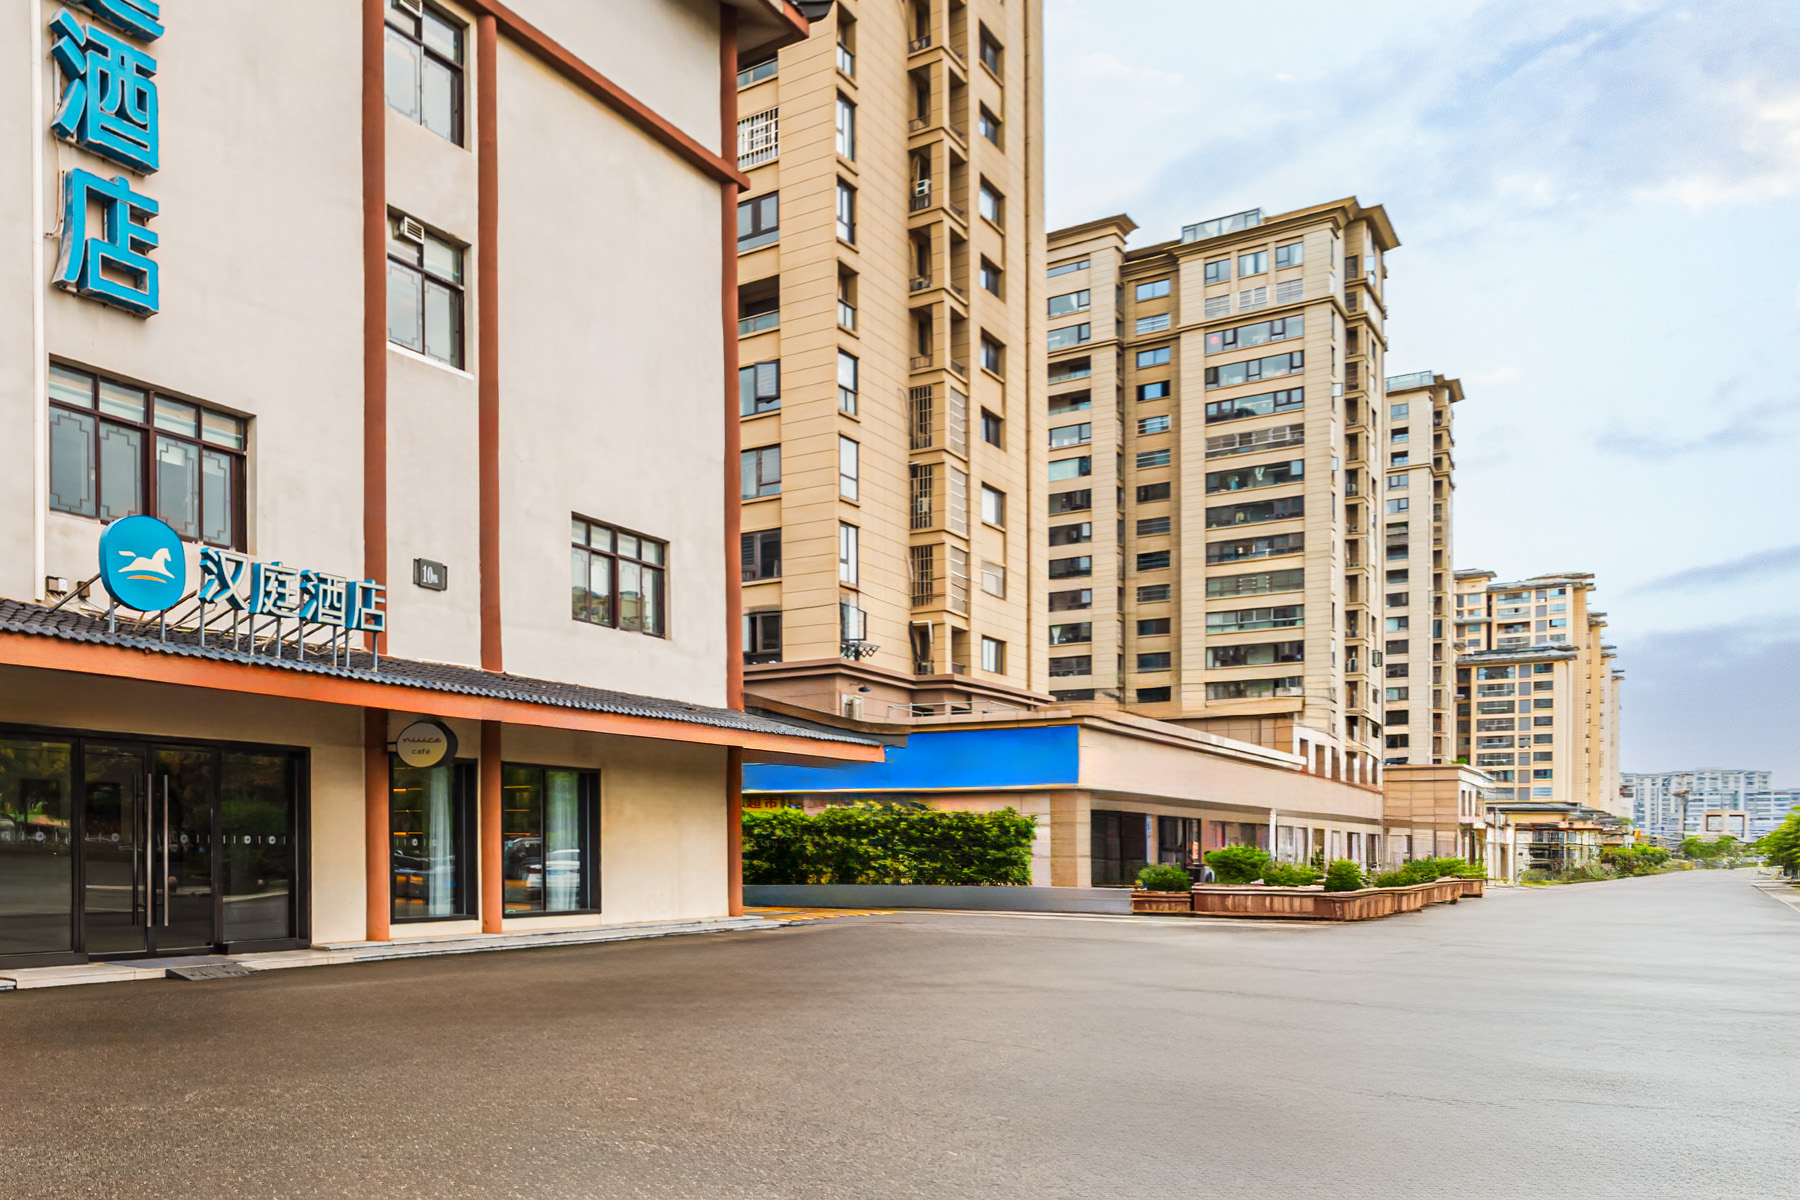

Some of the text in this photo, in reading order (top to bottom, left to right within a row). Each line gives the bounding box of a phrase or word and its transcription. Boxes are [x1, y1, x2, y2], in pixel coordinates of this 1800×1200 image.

[199, 547, 386, 632] 汉庭酒店
[742, 796, 778, 809] 超市
